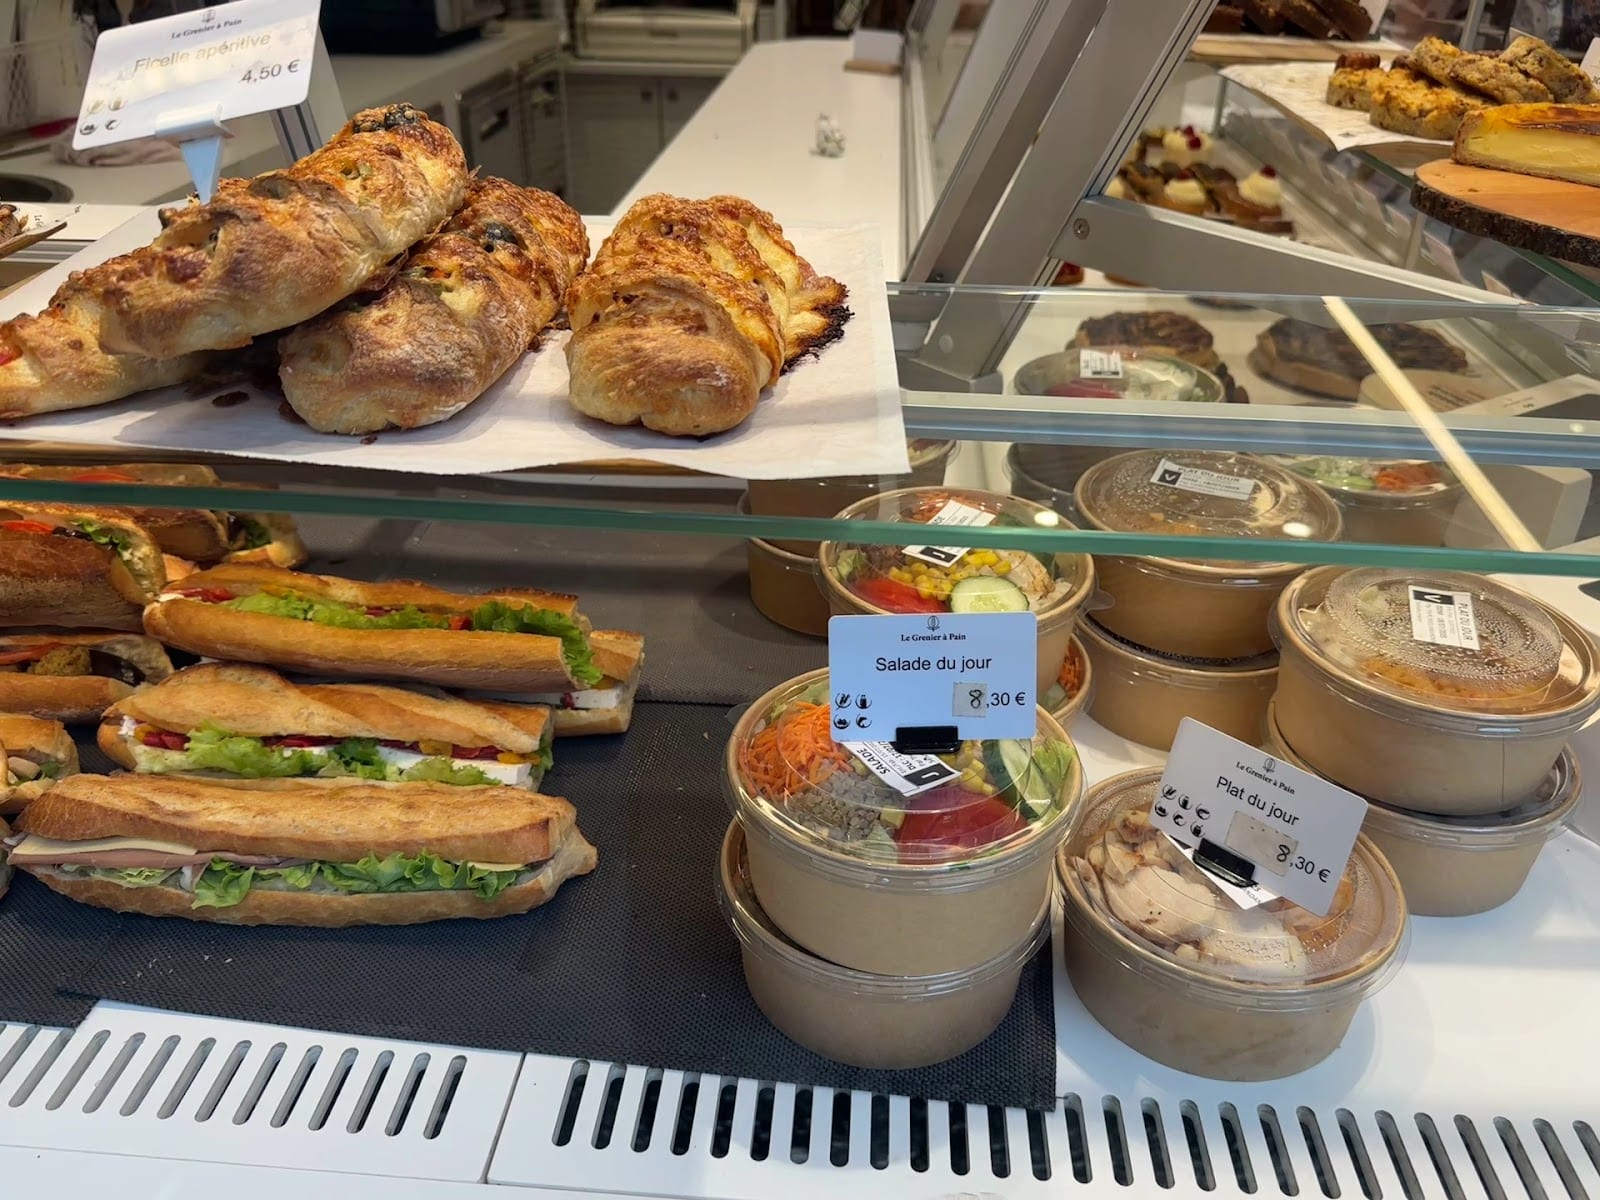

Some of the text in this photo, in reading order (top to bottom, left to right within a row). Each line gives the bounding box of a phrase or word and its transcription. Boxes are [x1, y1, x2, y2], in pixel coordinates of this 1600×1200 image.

[171, 32, 182, 40] Le
[183, 25, 215, 38] Grenier
[223, 18, 242, 28] Pain
[134, 32, 271, 73] Ficelle apéritive
[240, 59, 300, 84] 4,50 €
[949, 633, 966, 641] Pain
[876, 656, 992, 673] Salade du jour
[969, 689, 1026, 709] 8,30 €
[857, 748, 891, 775] SALADE
[1236, 761, 1245, 771] Le
[1245, 766, 1273, 784] Grenier
[1279, 780, 1295, 795] Pain
[1216, 775, 1299, 826] Plat du jour
[1276, 843, 1331, 883] 8,30 €
